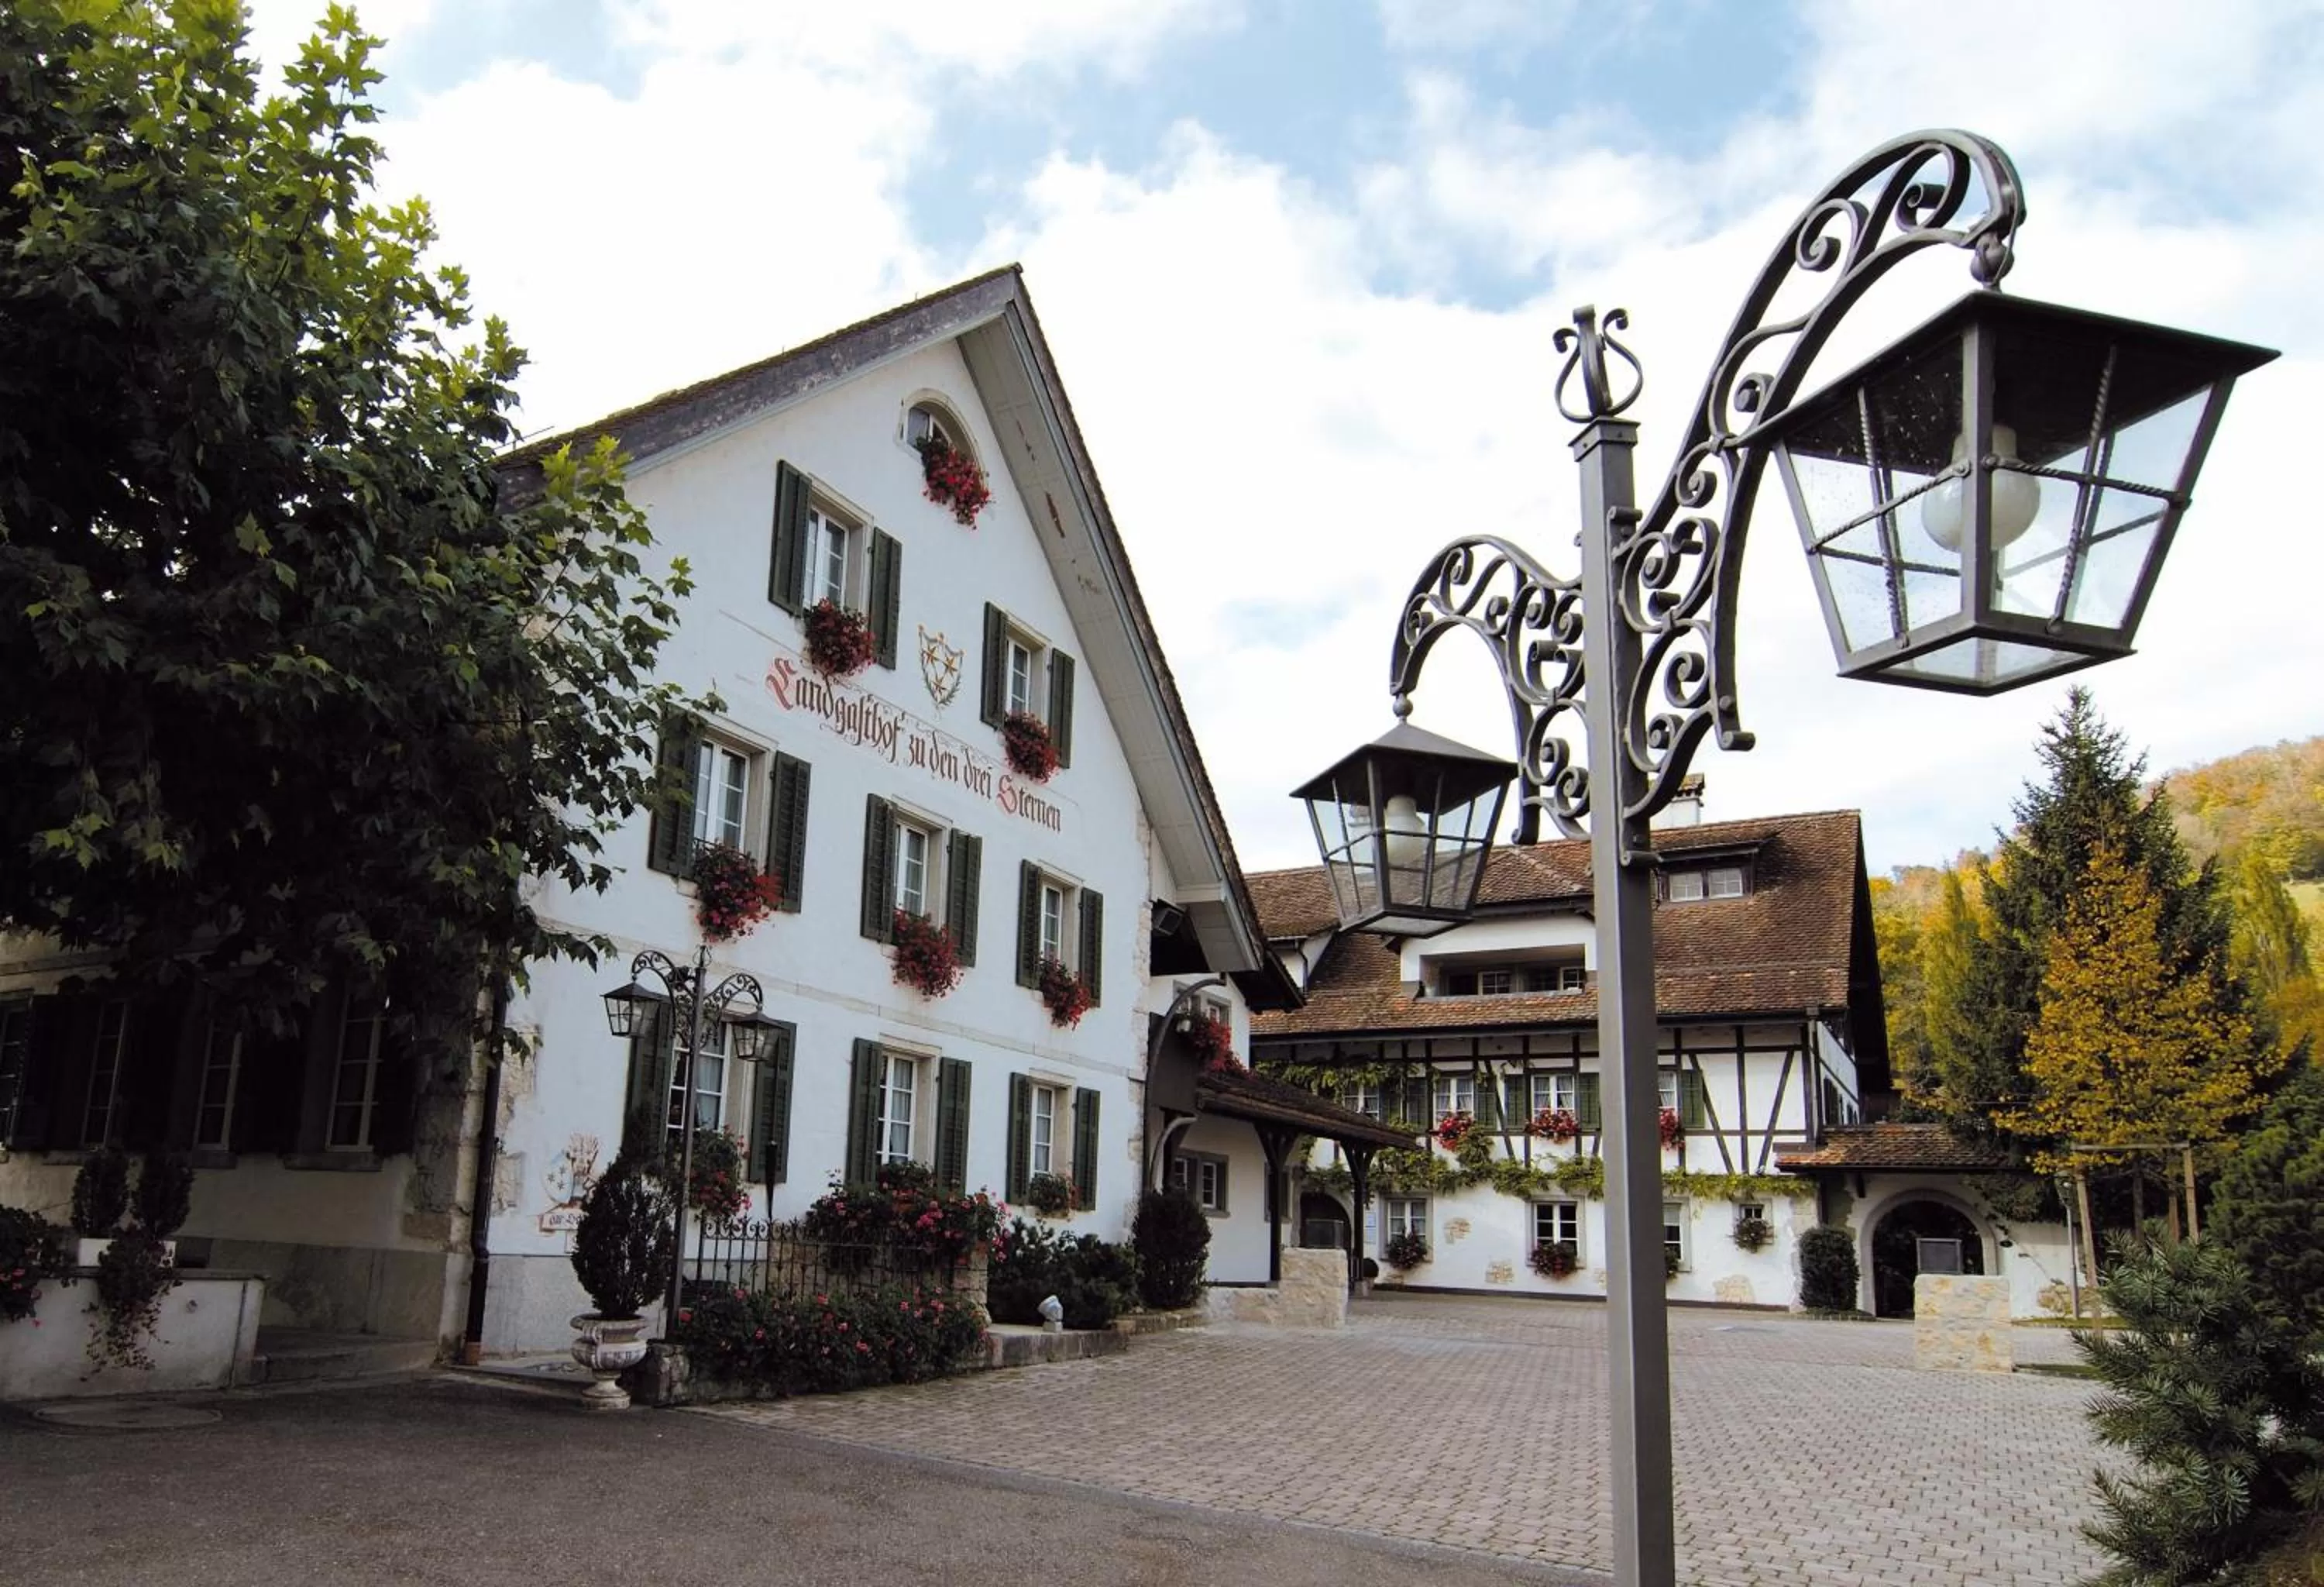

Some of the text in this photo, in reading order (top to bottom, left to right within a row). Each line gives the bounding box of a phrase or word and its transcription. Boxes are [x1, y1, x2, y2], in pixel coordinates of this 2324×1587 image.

[909, 734, 925, 768] zu
[929, 731, 958, 783] den
[964, 747, 992, 800] drei
[997, 774, 1061, 832] Sternen
